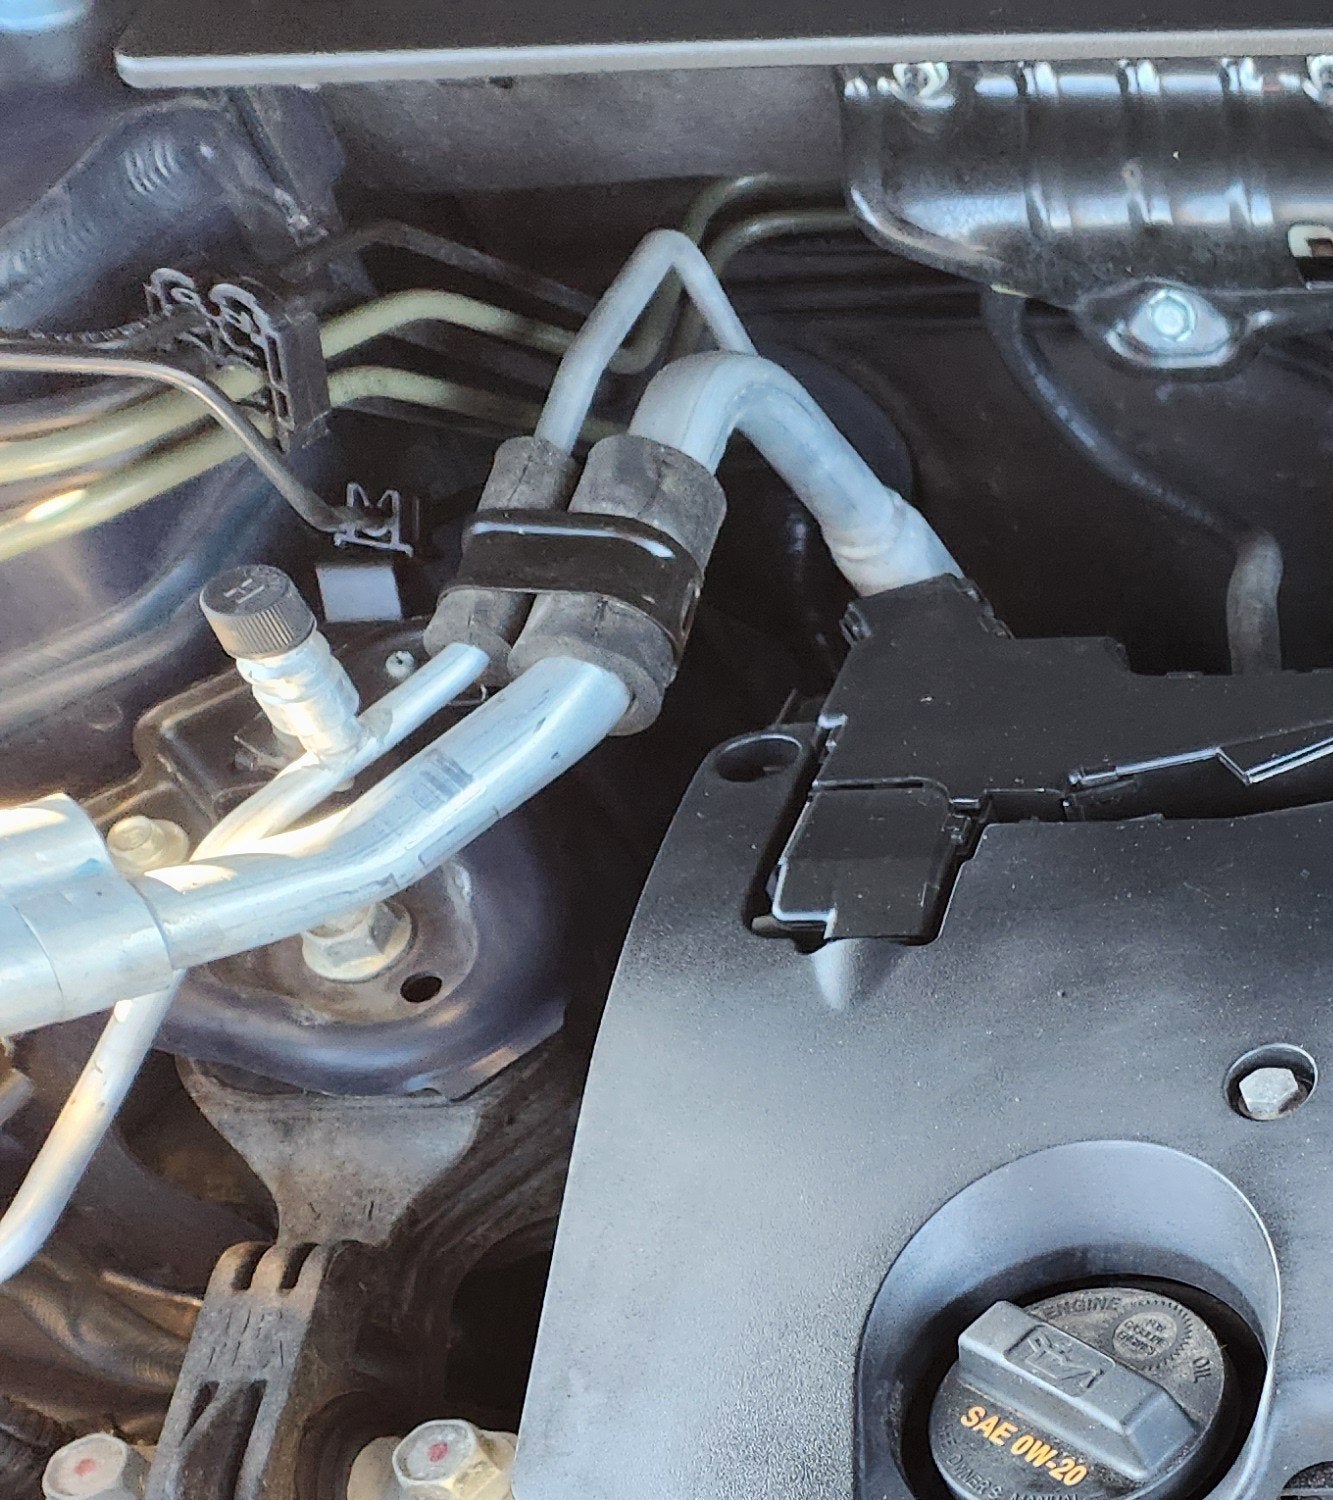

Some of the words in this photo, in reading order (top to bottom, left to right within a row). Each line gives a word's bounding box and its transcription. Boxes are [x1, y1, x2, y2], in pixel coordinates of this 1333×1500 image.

[1044, 1296, 1122, 1319] ENGINE
[1192, 1356, 1212, 1384] OIL
[960, 1405, 1019, 1446] SAE
[1010, 1434, 1089, 1487] 0W-20
